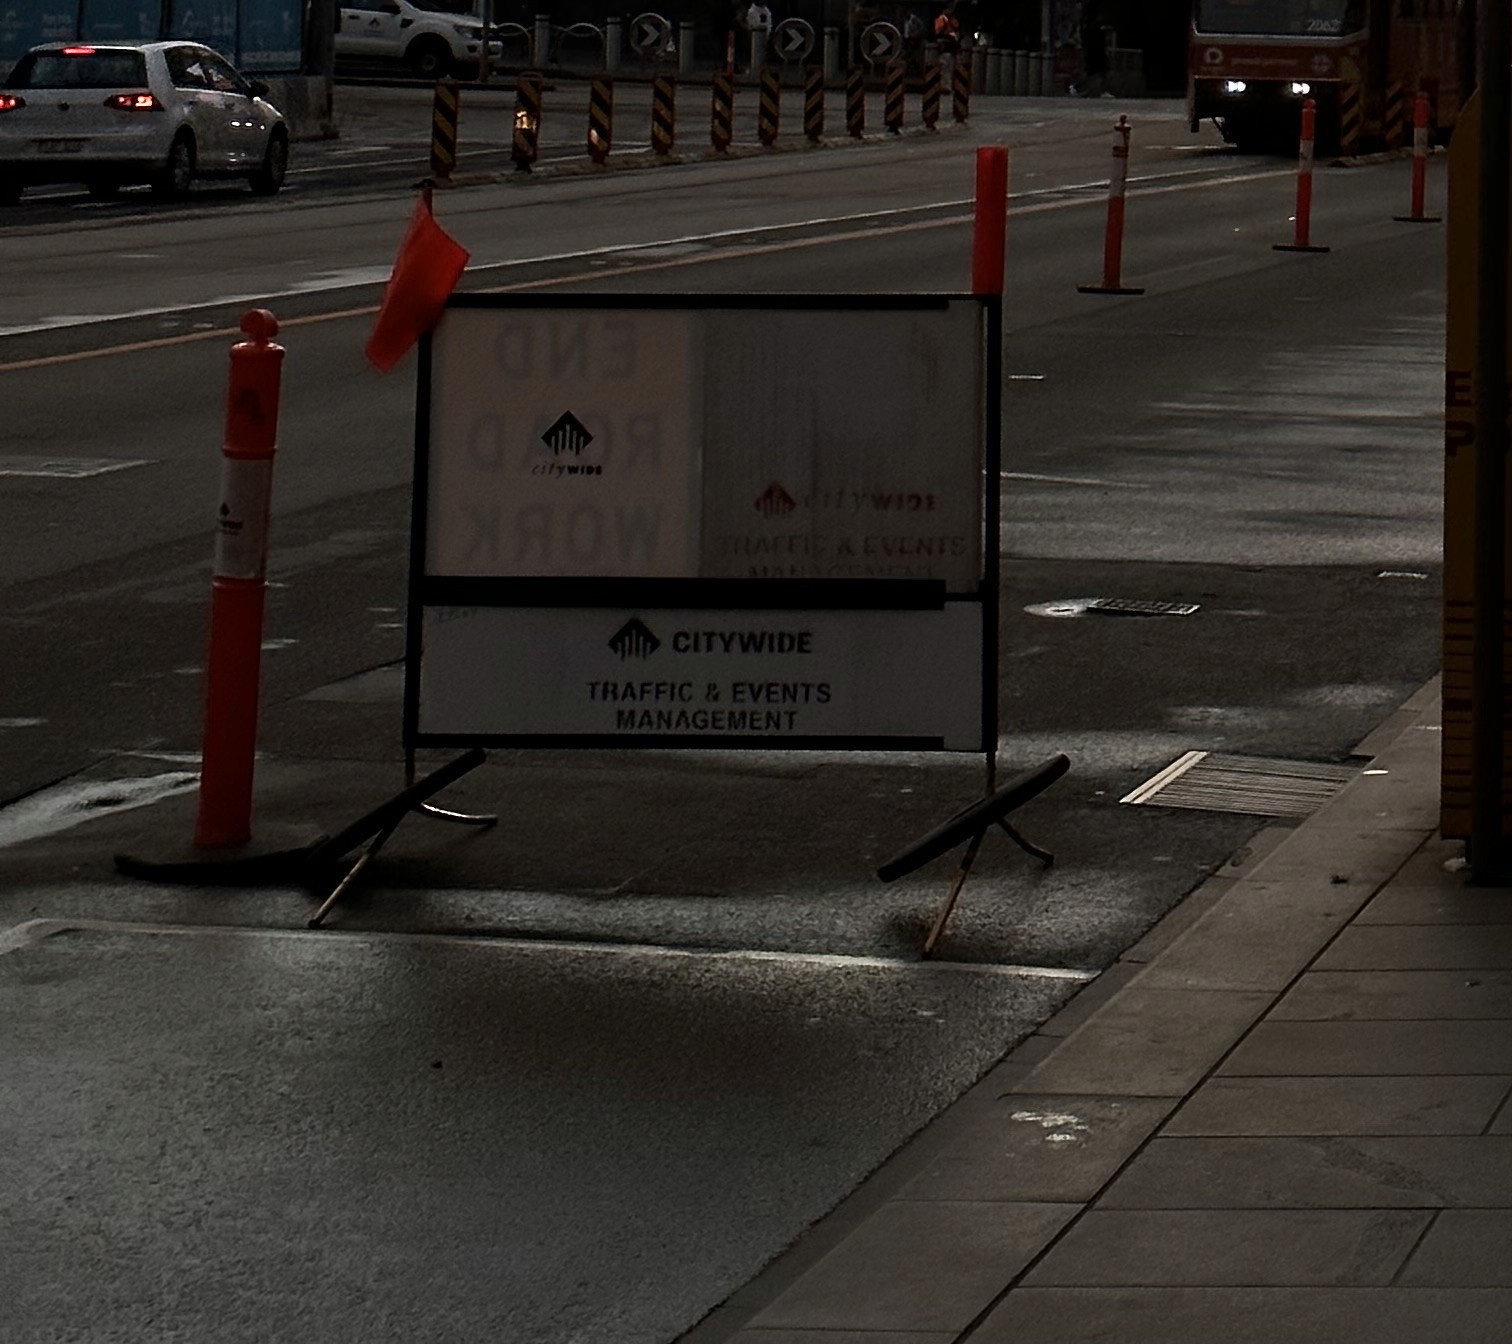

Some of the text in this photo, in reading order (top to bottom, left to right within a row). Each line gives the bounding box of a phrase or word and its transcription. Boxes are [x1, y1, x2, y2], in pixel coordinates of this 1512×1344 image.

[719, 535, 828, 557] TRAFFIC
[863, 535, 967, 557] EVENTS
[671, 630, 813, 655] CITYWIDE
[585, 681, 832, 704] TRAFFIC & EVENTS
[616, 709, 800, 732] MANAGEMENT
